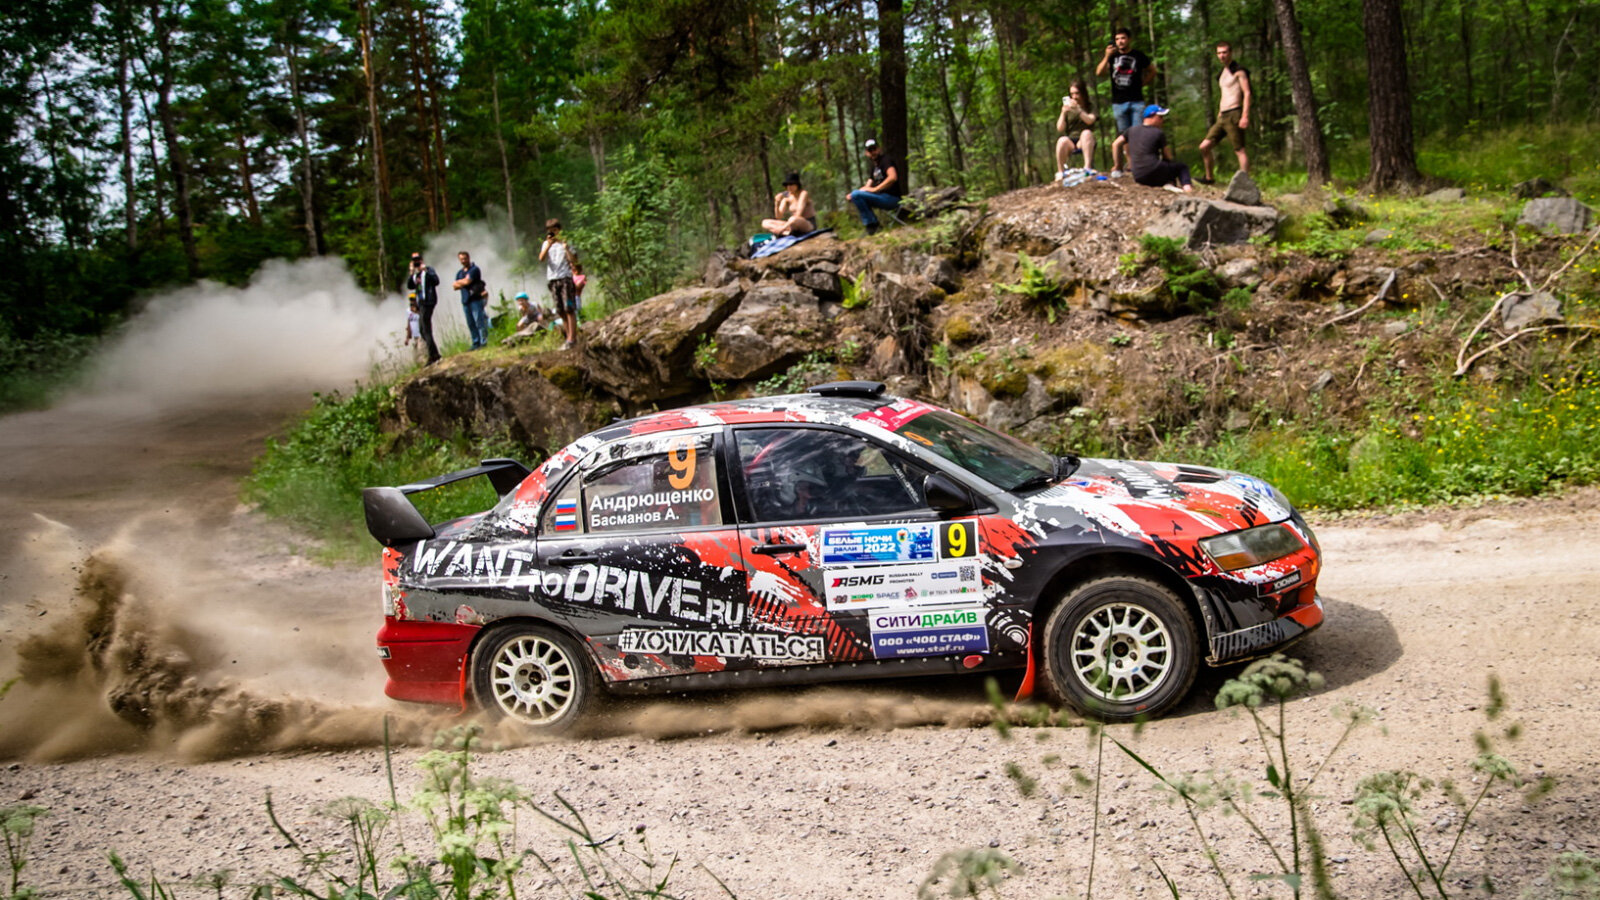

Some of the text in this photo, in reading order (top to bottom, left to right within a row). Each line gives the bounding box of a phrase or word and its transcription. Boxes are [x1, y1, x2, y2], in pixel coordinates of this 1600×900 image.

[668, 436, 697, 490] 9
[590, 488, 714, 511] Андрющенко
[591, 508, 680, 527] Басманов А.
[828, 535, 892, 545] БЕЛЫЕ НОЧИ
[864, 543, 896, 553] 2022
[948, 522, 967, 557] 9
[413, 539, 533, 589] WANT
[837, 574, 885, 587] ASMG
[876, 609, 977, 628] СИТИДРАЙВ
[619, 629, 825, 660] #ХОЧУКАТАТЬСЯ
[879, 637, 903, 647] ООО
[896, 644, 965, 654] www.staf.ru
